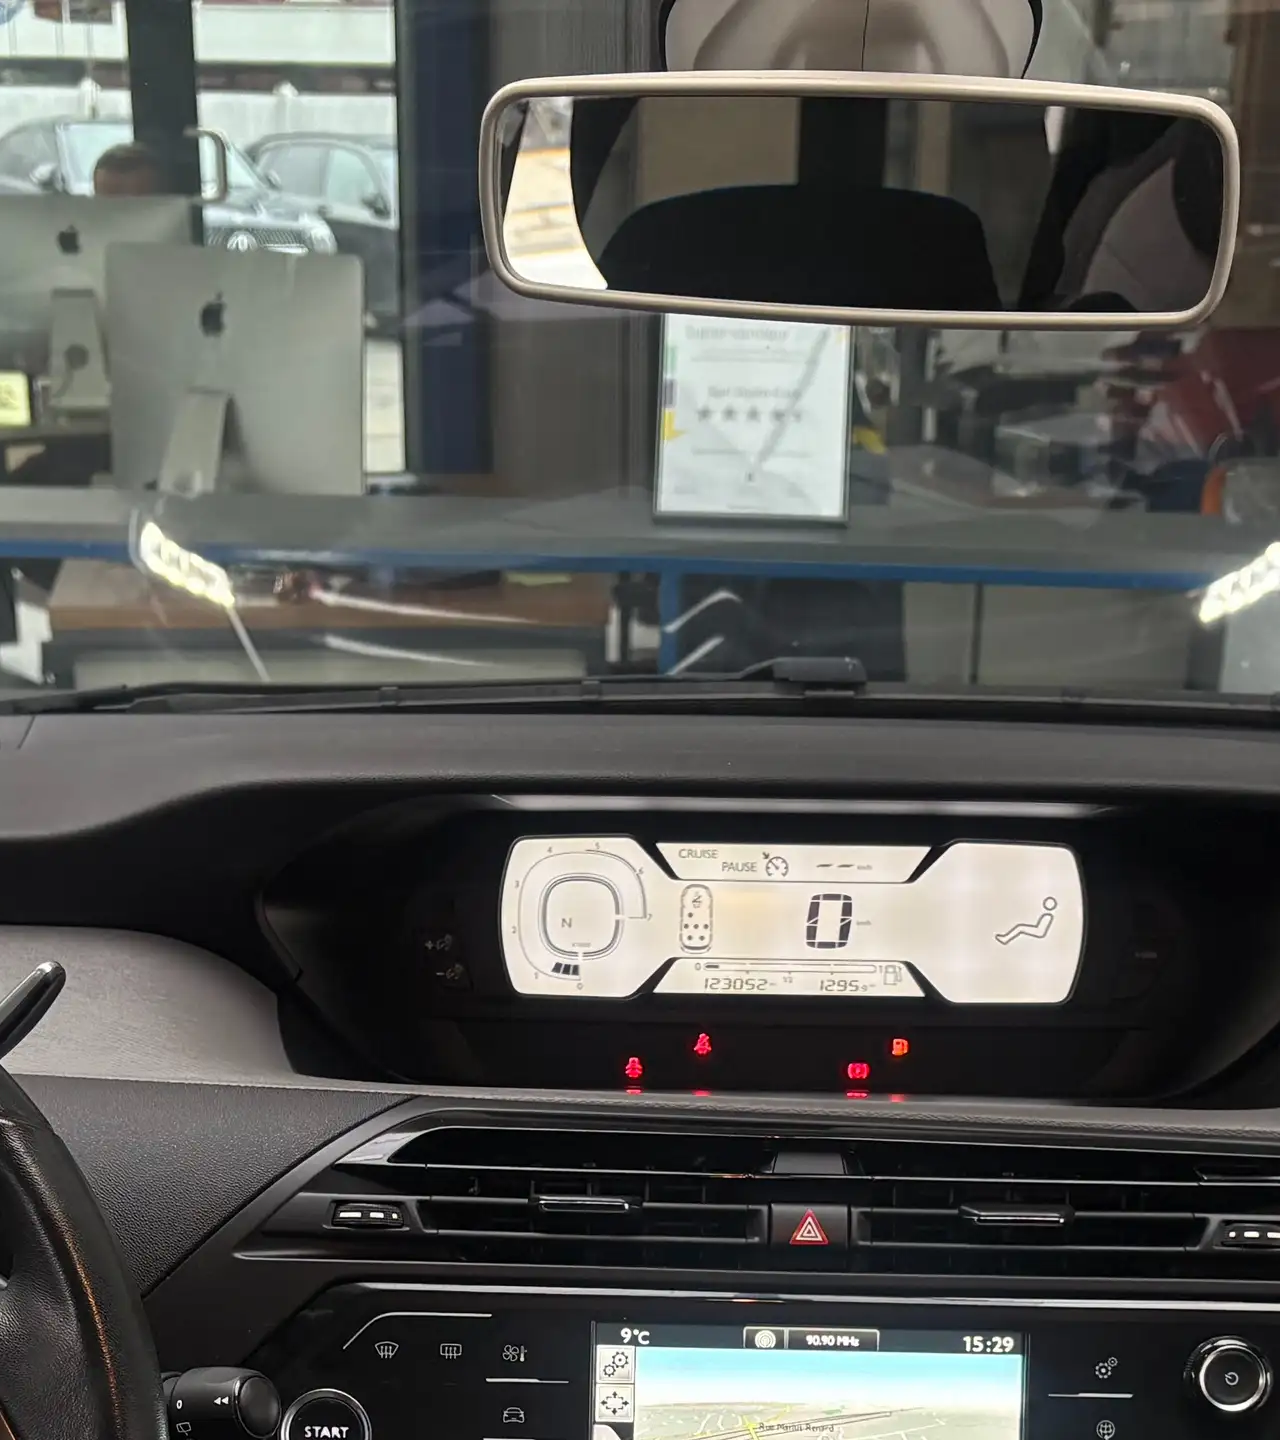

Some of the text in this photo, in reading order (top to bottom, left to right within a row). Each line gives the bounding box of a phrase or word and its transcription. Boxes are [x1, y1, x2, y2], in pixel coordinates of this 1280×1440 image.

[678, 848, 719, 859] CRUISE
[721, 861, 758, 873] PAUSE
[561, 917, 572, 928] N
[806, 893, 853, 949] 0
[705, 977, 768, 990] 123052
[620, 1327, 650, 1345] 9°C
[805, 1334, 860, 1347] 90.90 MHz
[963, 1335, 1014, 1353] 15:29
[304, 1426, 349, 1439] START
